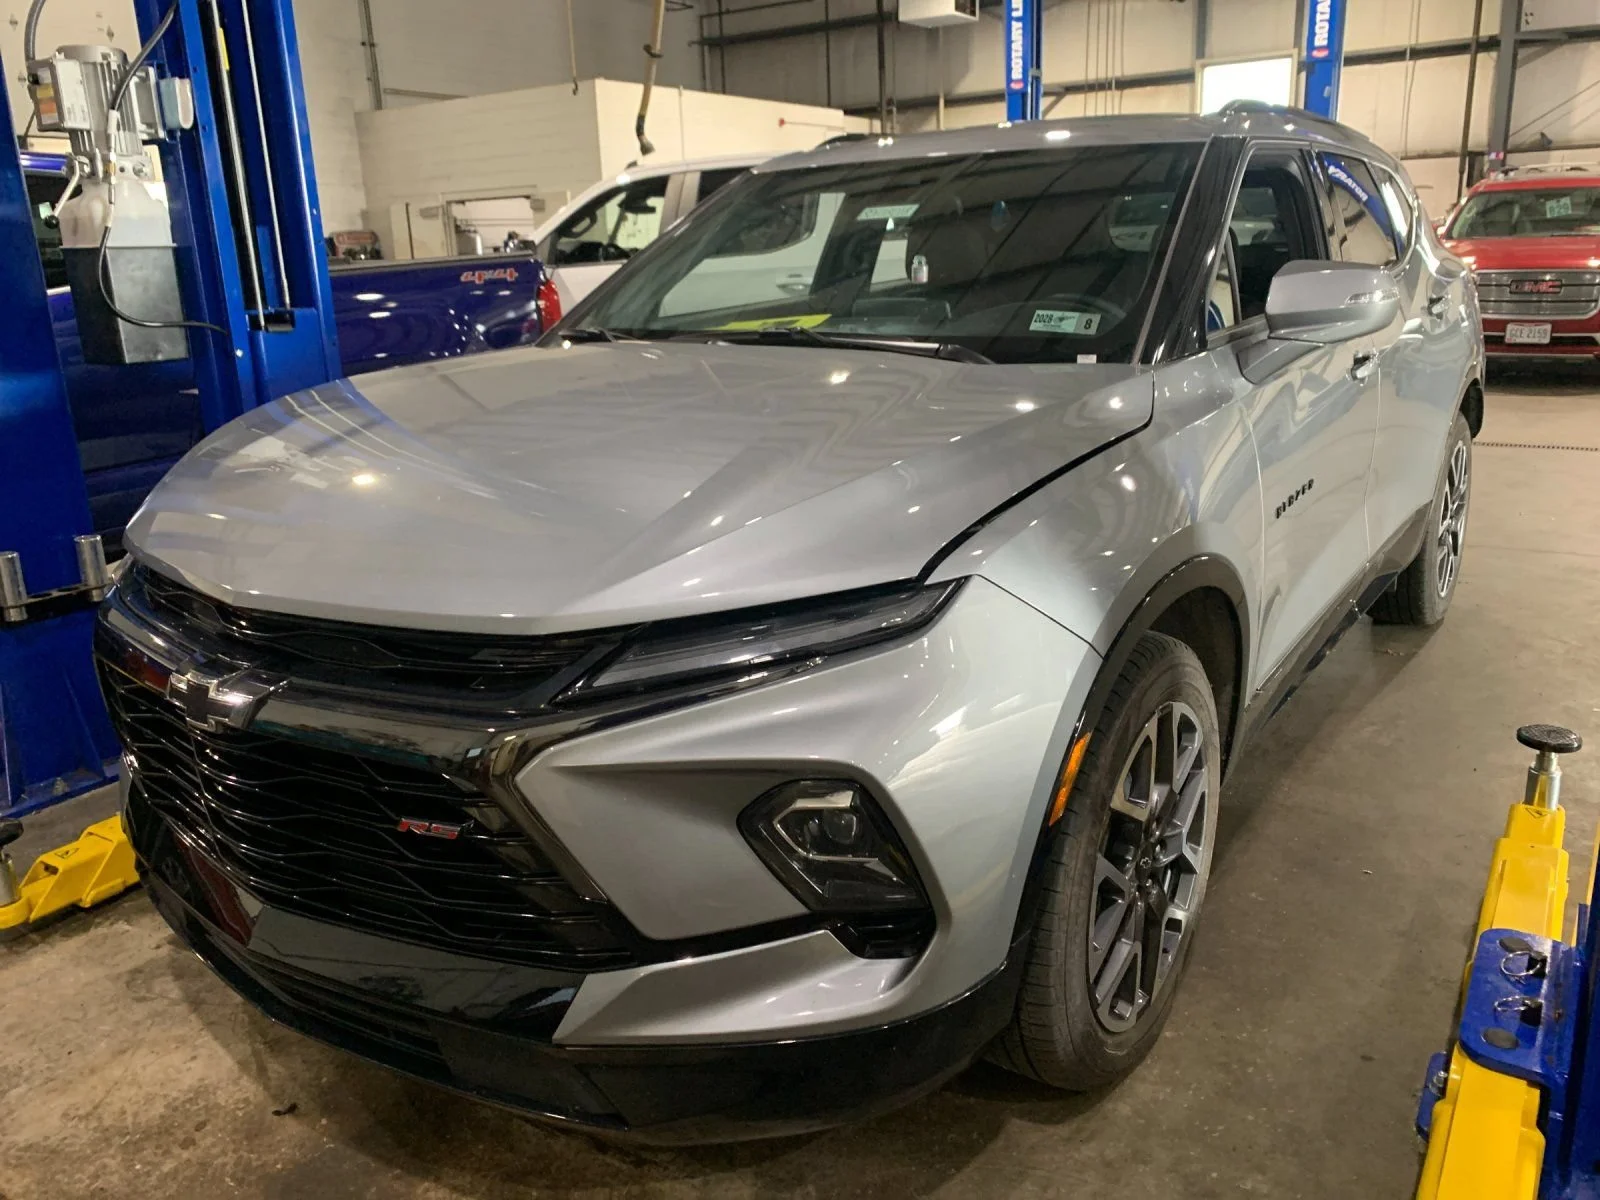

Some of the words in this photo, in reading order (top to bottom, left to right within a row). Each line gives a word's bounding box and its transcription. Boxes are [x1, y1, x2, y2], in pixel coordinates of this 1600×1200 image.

[1314, 0, 1331, 47] ROTA
[1011, 21, 1023, 80] ROTARY
[1510, 281, 1562, 293] GMC
[1034, 313, 1054, 324] 2028
[1084, 318, 1093, 330] 8
[1276, 478, 1314, 519] BLAZER
[398, 818, 461, 840] RS
